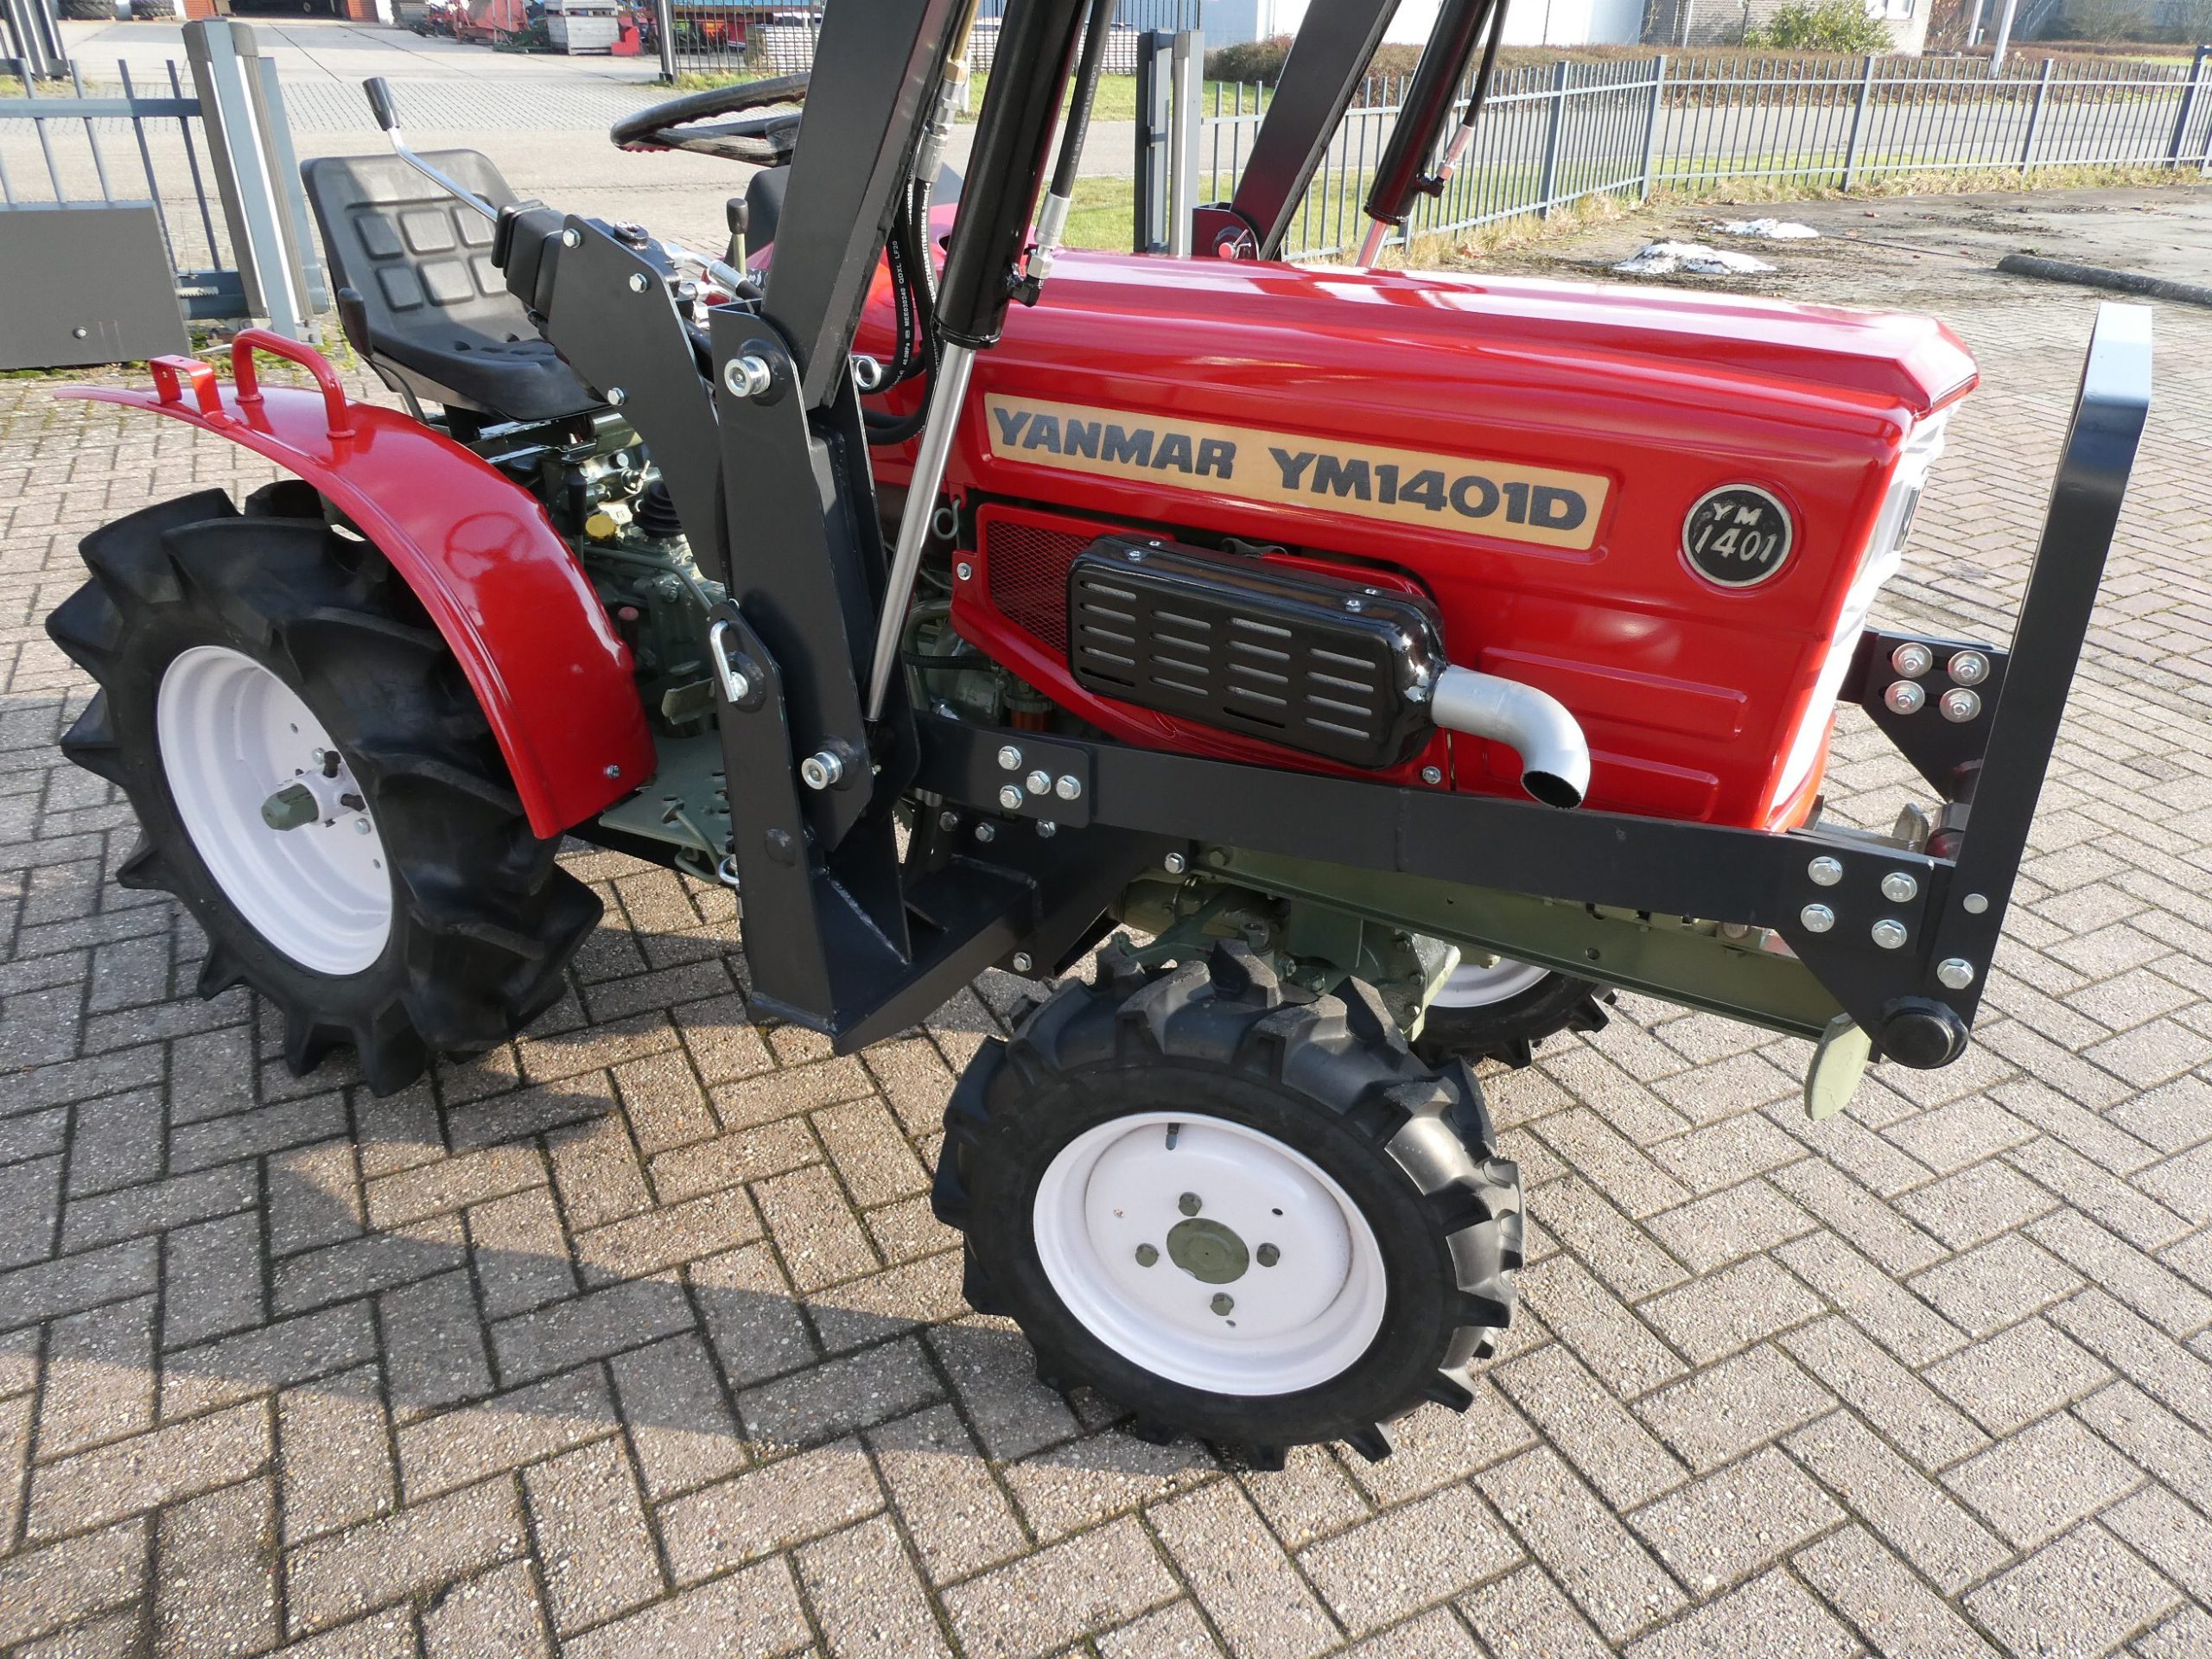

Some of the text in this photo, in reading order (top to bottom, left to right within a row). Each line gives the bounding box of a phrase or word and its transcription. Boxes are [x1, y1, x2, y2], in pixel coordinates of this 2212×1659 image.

[993, 408, 1587, 531] YANMAR YM1401D
[1713, 502, 1763, 526] YM
[1694, 524, 1777, 563] 1401
